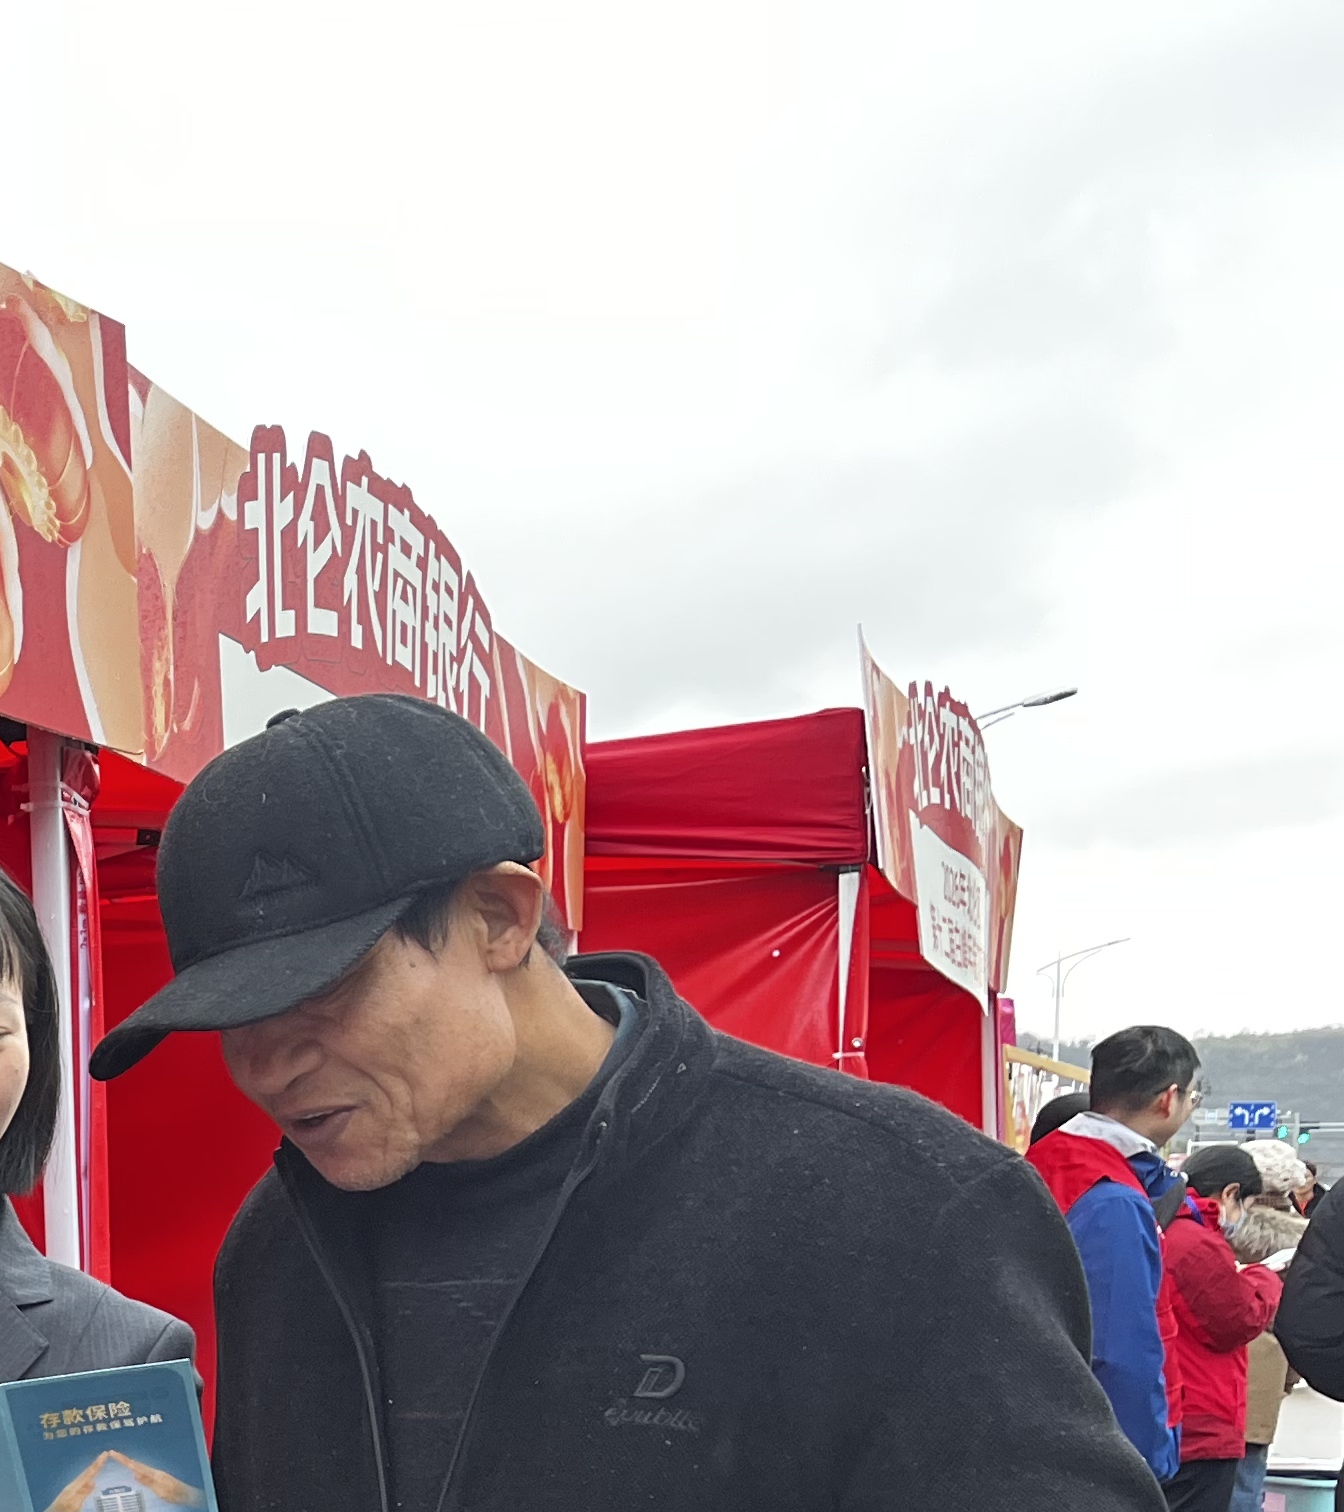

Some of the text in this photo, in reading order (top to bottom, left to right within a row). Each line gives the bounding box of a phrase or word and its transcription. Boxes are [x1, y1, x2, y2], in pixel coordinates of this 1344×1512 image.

[244, 452, 491, 725] 北仑农商银行
[39, 1400, 132, 1429] 存款保险
